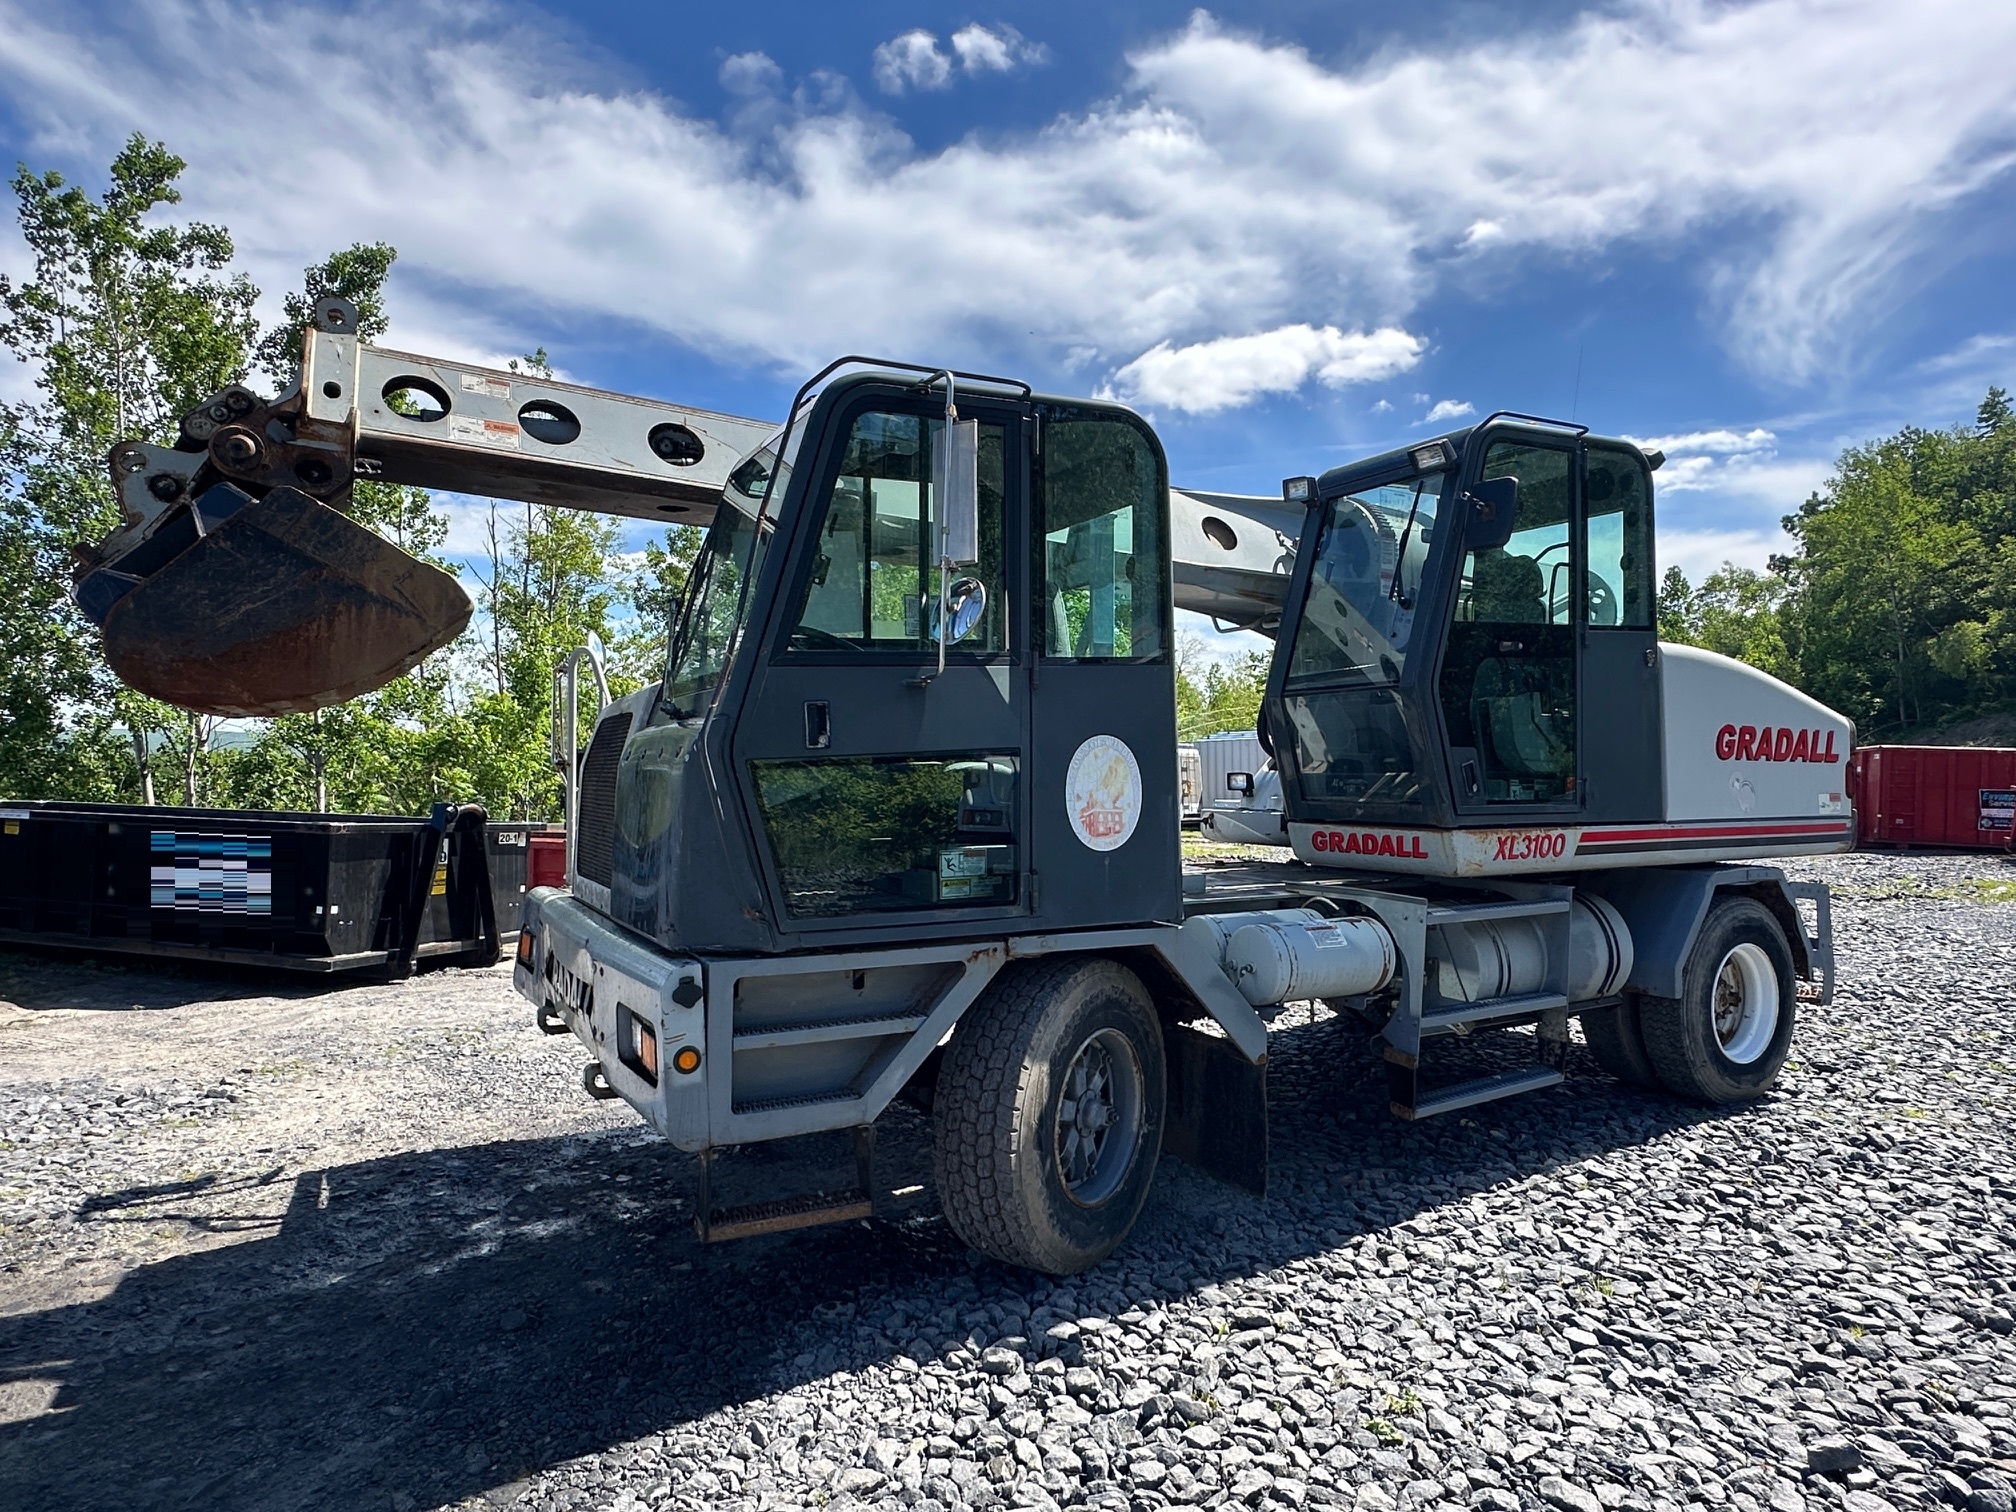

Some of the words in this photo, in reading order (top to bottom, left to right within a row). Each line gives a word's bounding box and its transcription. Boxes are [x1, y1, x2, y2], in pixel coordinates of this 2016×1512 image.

[1716, 724, 1839, 763] GRADALL
[500, 833, 518, 843] 20-1
[1312, 831, 1428, 859] GRADALL
[1493, 833, 1565, 861] XL3100
